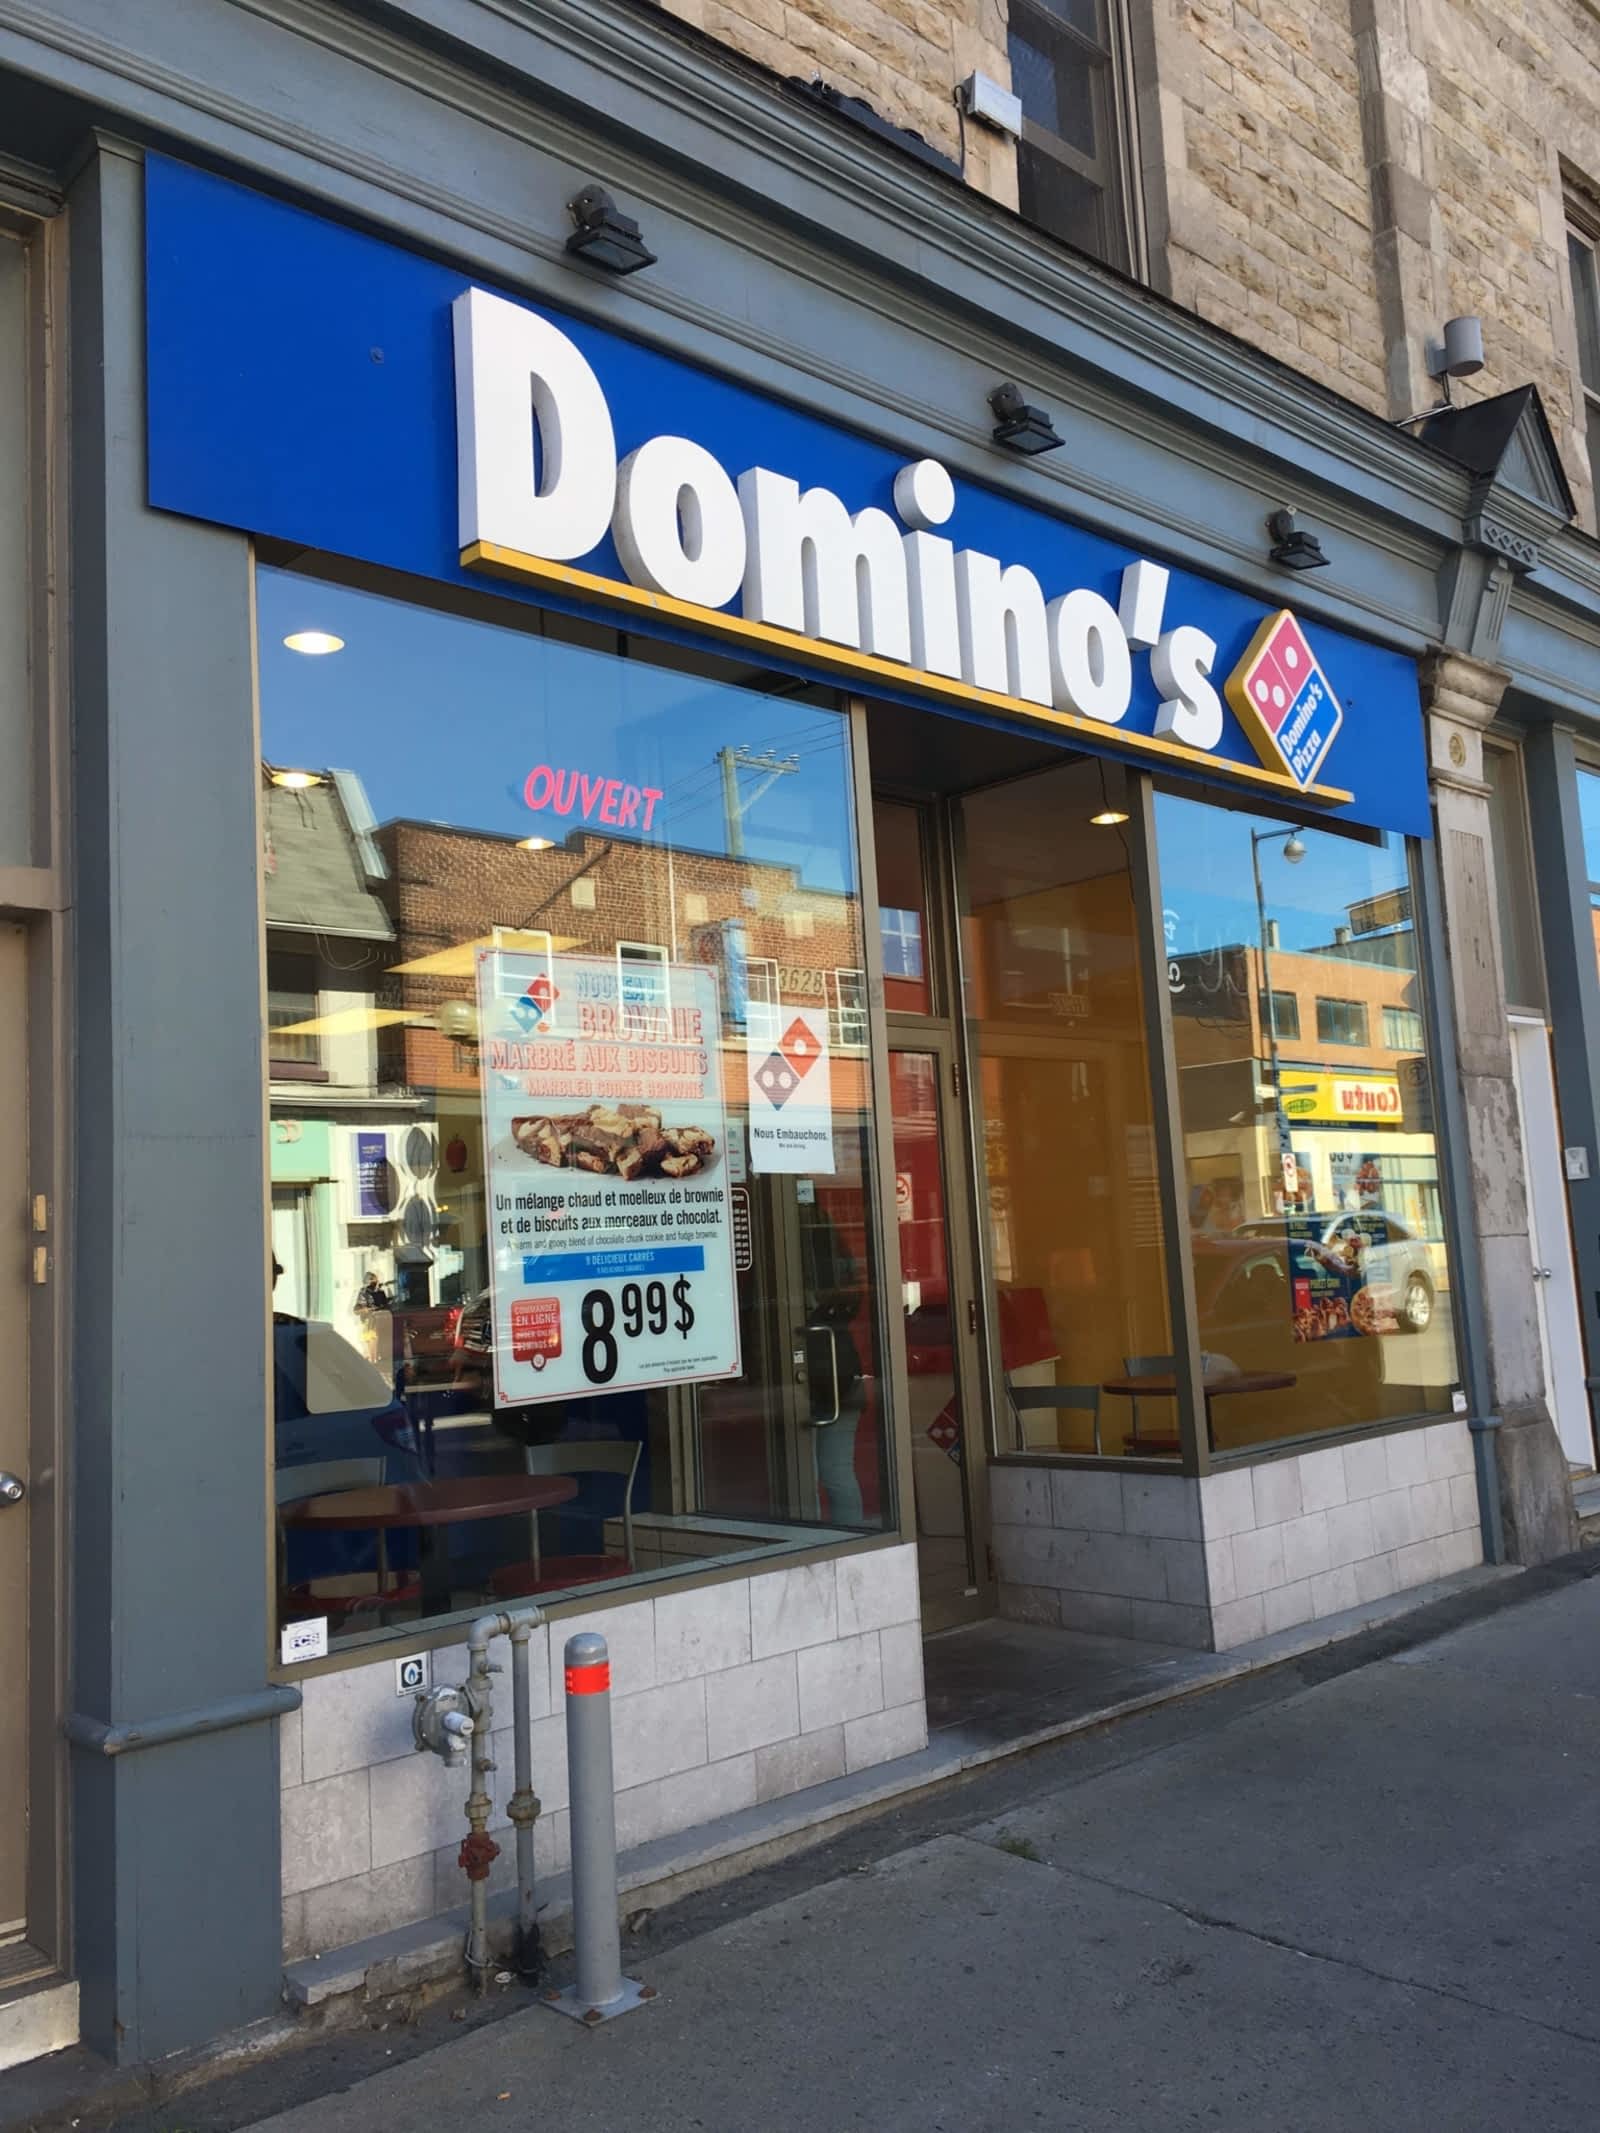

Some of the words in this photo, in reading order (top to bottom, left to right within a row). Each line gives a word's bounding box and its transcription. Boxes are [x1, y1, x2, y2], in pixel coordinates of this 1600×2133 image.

[453, 286, 1224, 751] Domino's
[1280, 682, 1324, 756] Domino's
[1291, 729, 1322, 778] Pizza
[524, 764, 664, 831] OUVERT
[779, 967, 823, 993] 3628
[578, 1001, 704, 1045] BROWNIE
[491, 1039, 577, 1071] MARBRÉ
[582, 1044, 621, 1073] AUX
[628, 1047, 708, 1076] BISCUITS
[527, 1078, 593, 1098] MARBLED
[754, 1128, 774, 1139] Nous
[496, 1194, 512, 1210] Un
[515, 1192, 565, 1211] mélange
[568, 1190, 602, 1208] chaud
[605, 1191, 616, 1206] et
[620, 1189, 667, 1205] moelleux
[669, 1188, 681, 1204] de
[684, 1187, 724, 1203] brownie
[501, 1218, 513, 1234] et
[517, 1216, 531, 1233] de
[534, 1214, 579, 1232] biscuits
[582, 1216, 601, 1229] aux
[605, 1214, 658, 1228] morceaux
[661, 1211, 673, 1225] de
[676, 1208, 722, 1225] chocolat.
[513, 1241, 532, 1249] arm
